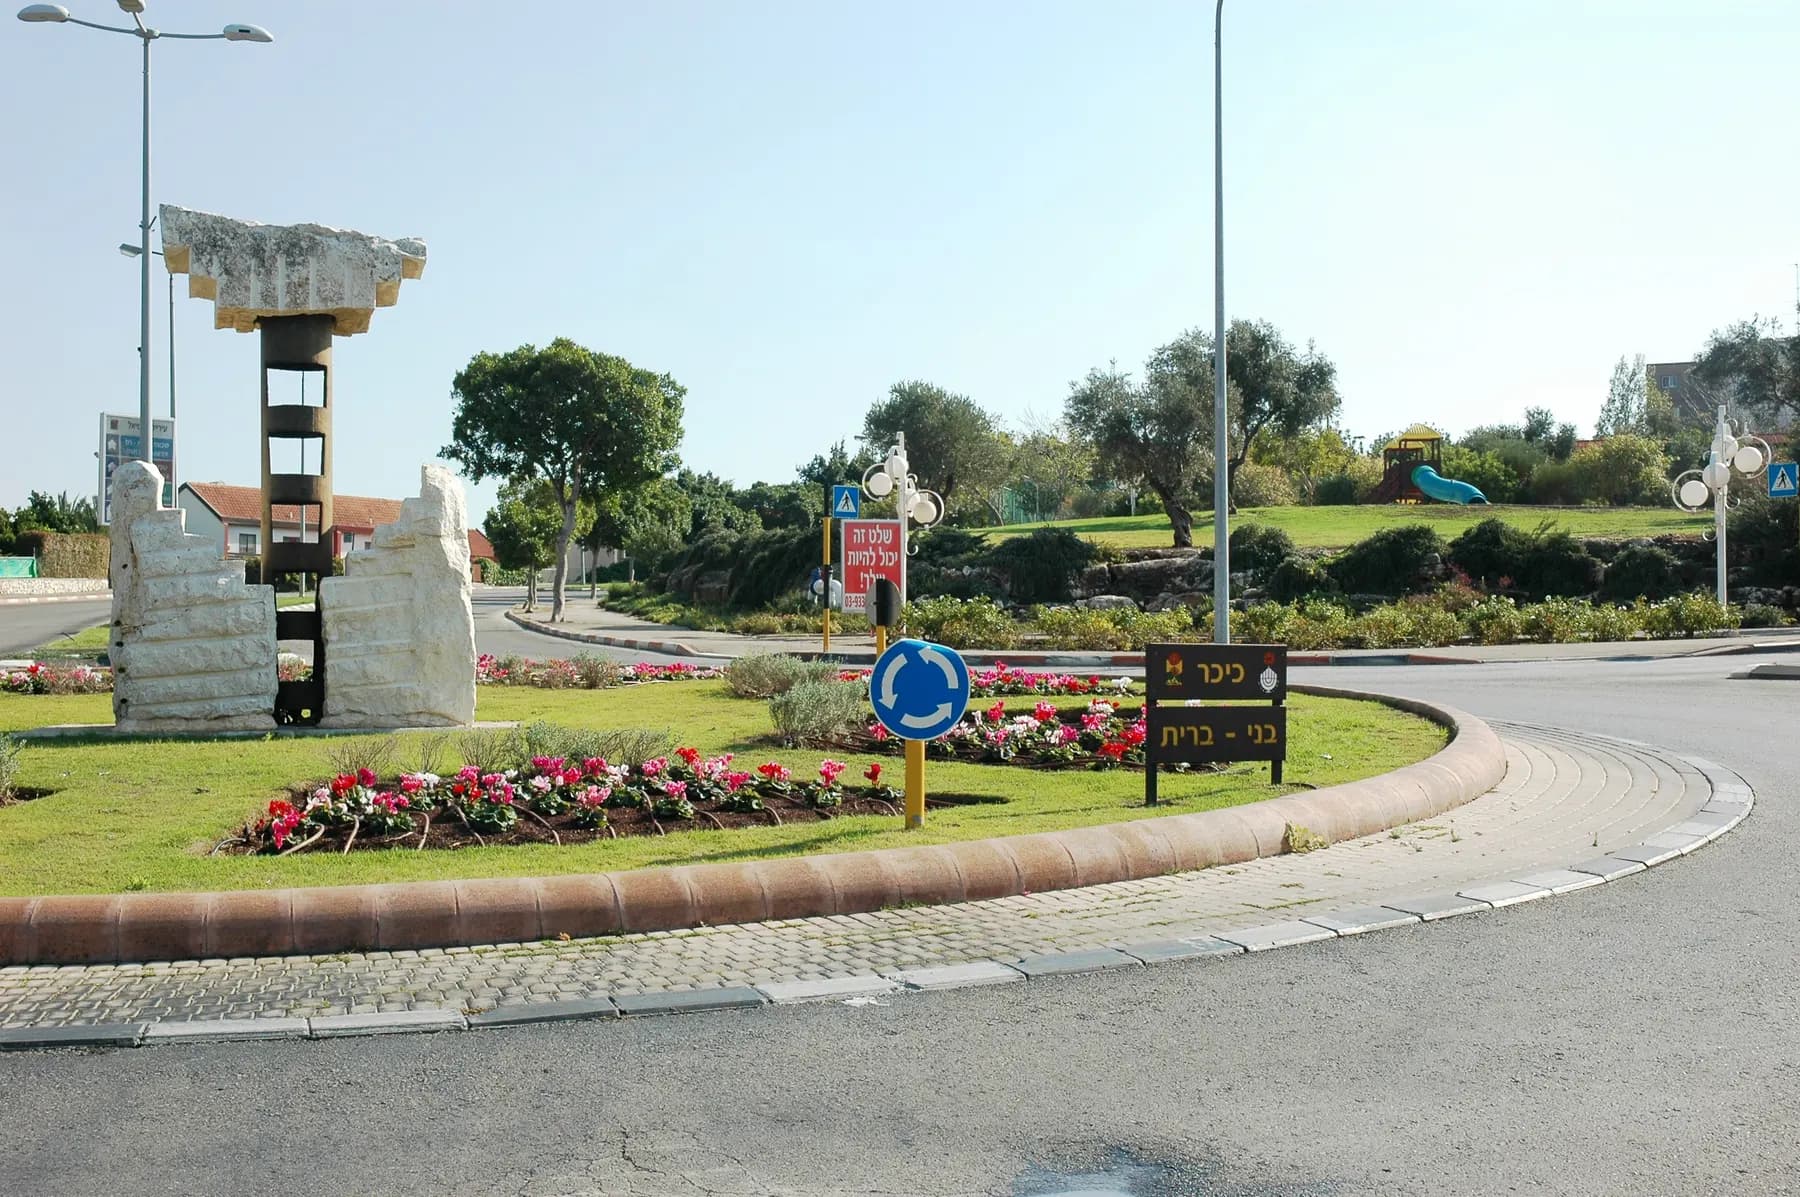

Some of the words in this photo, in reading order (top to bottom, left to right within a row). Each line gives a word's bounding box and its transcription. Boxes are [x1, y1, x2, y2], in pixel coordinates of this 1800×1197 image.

[853, 528, 865, 543] זה
[869, 524, 892, 544] שלט
[847, 546, 876, 566] להיות
[879, 546, 898, 566] יכול
[860, 569, 886, 591] לך!
[1197, 663, 1246, 684] כיכר
[1160, 725, 1215, 747] ברית
[1247, 724, 1278, 744] בני
